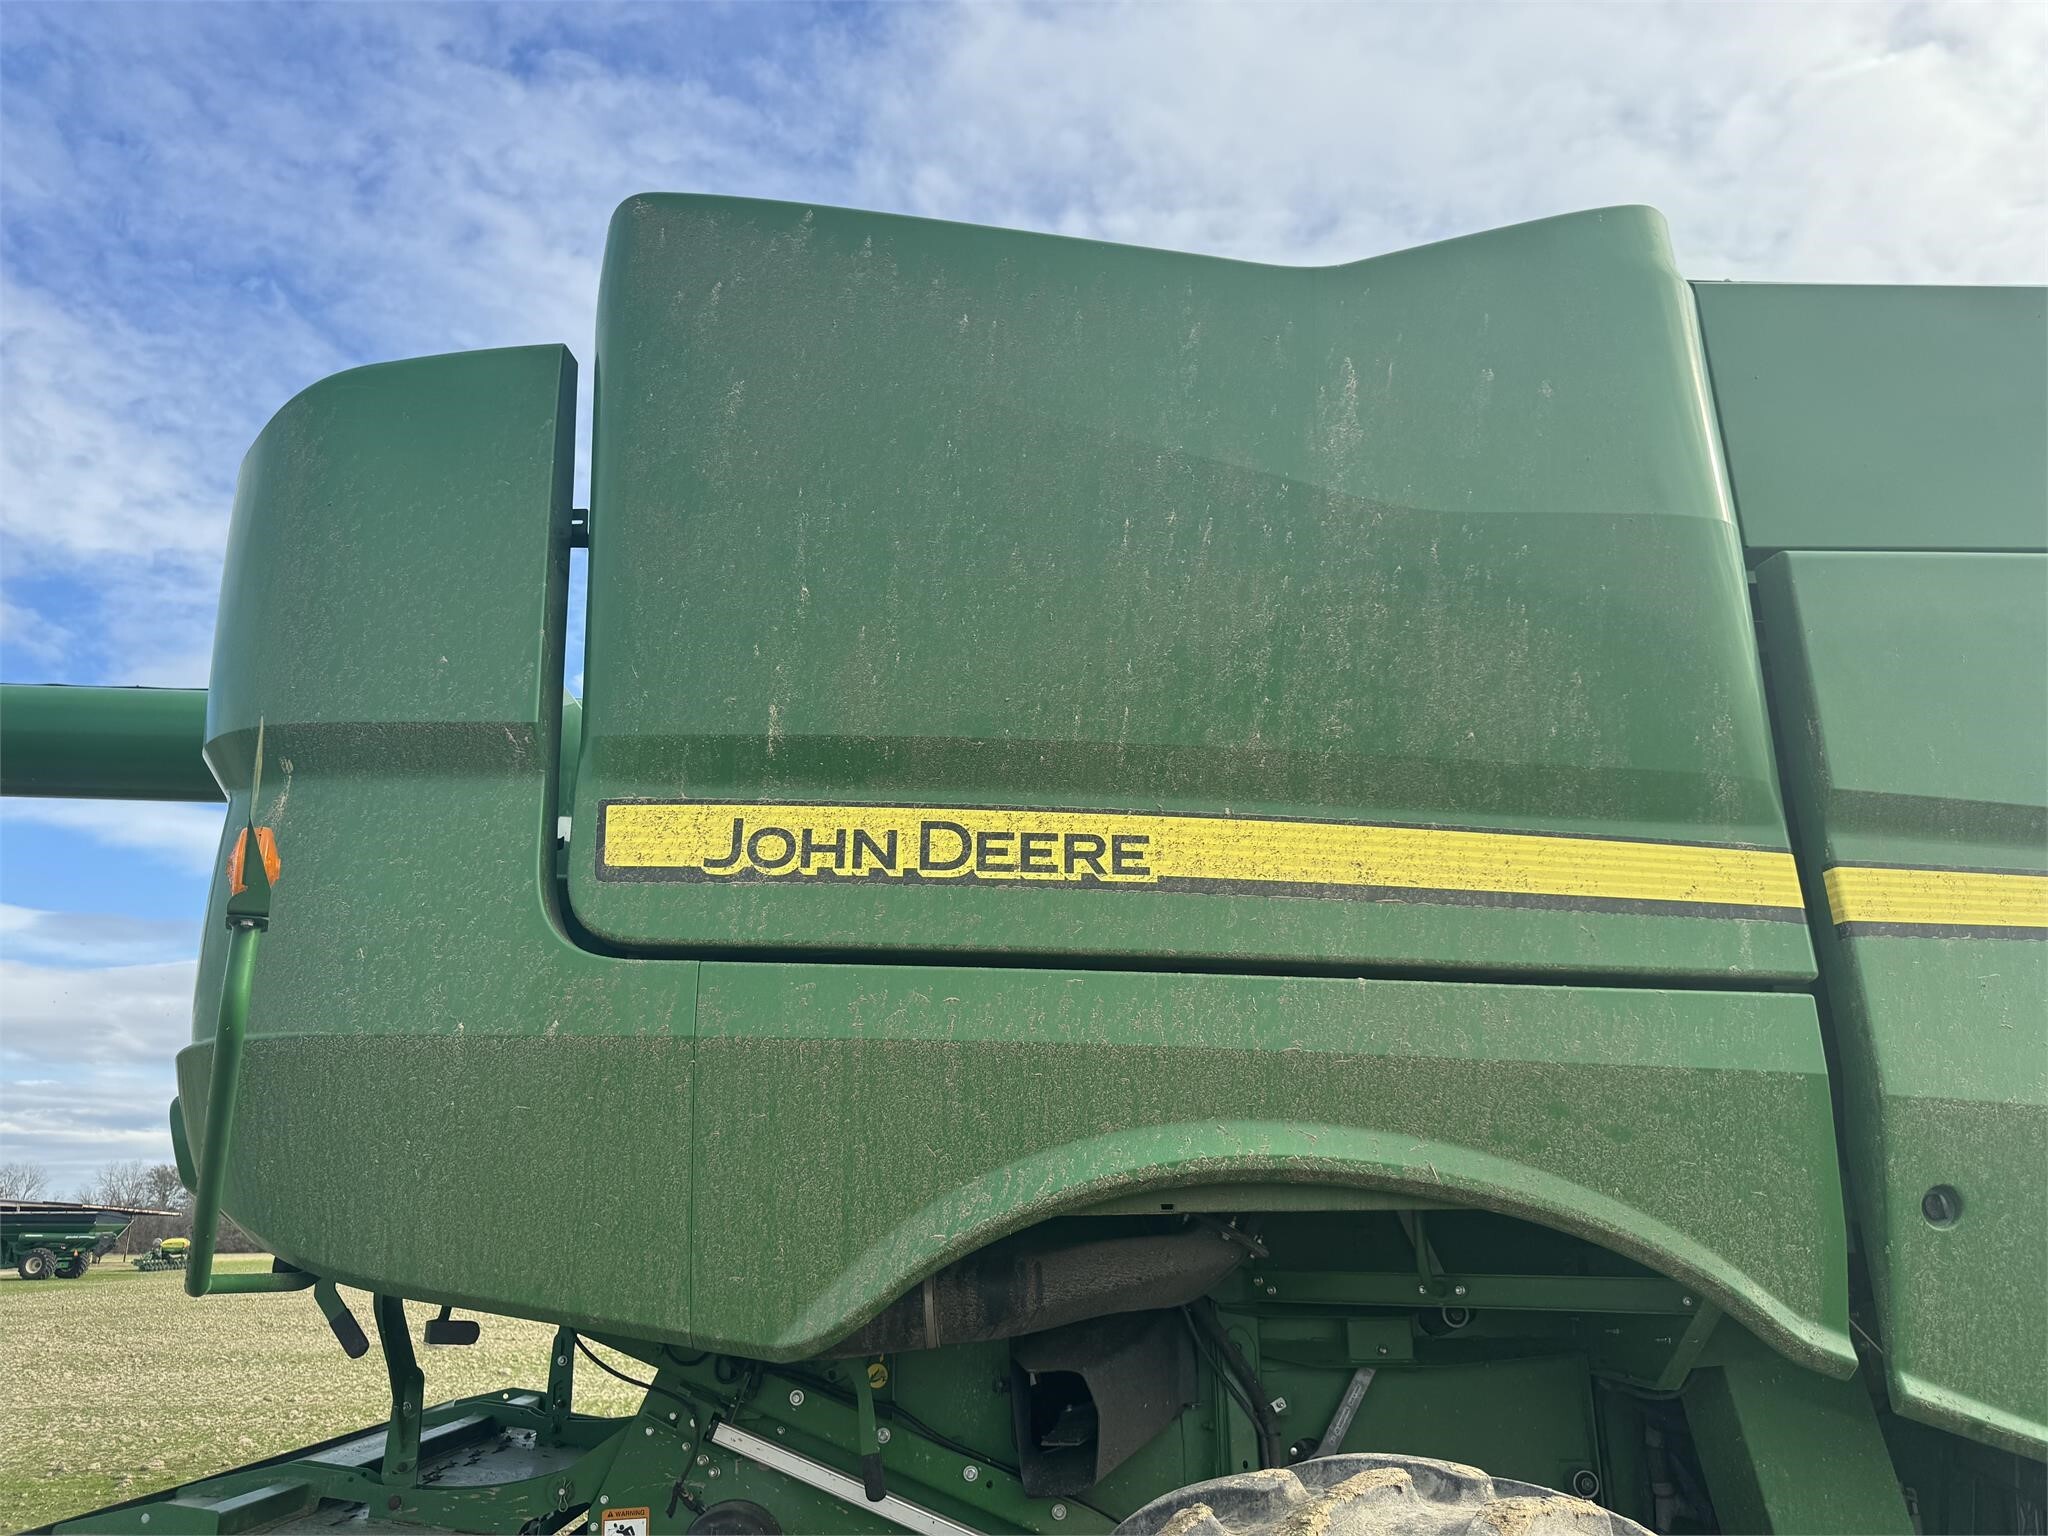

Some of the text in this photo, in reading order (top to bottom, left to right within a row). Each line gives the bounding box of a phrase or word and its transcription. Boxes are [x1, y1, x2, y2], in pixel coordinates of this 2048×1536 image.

[703, 817, 1151, 876] JOHN DEERE
[615, 1509, 645, 1517] WARNING
